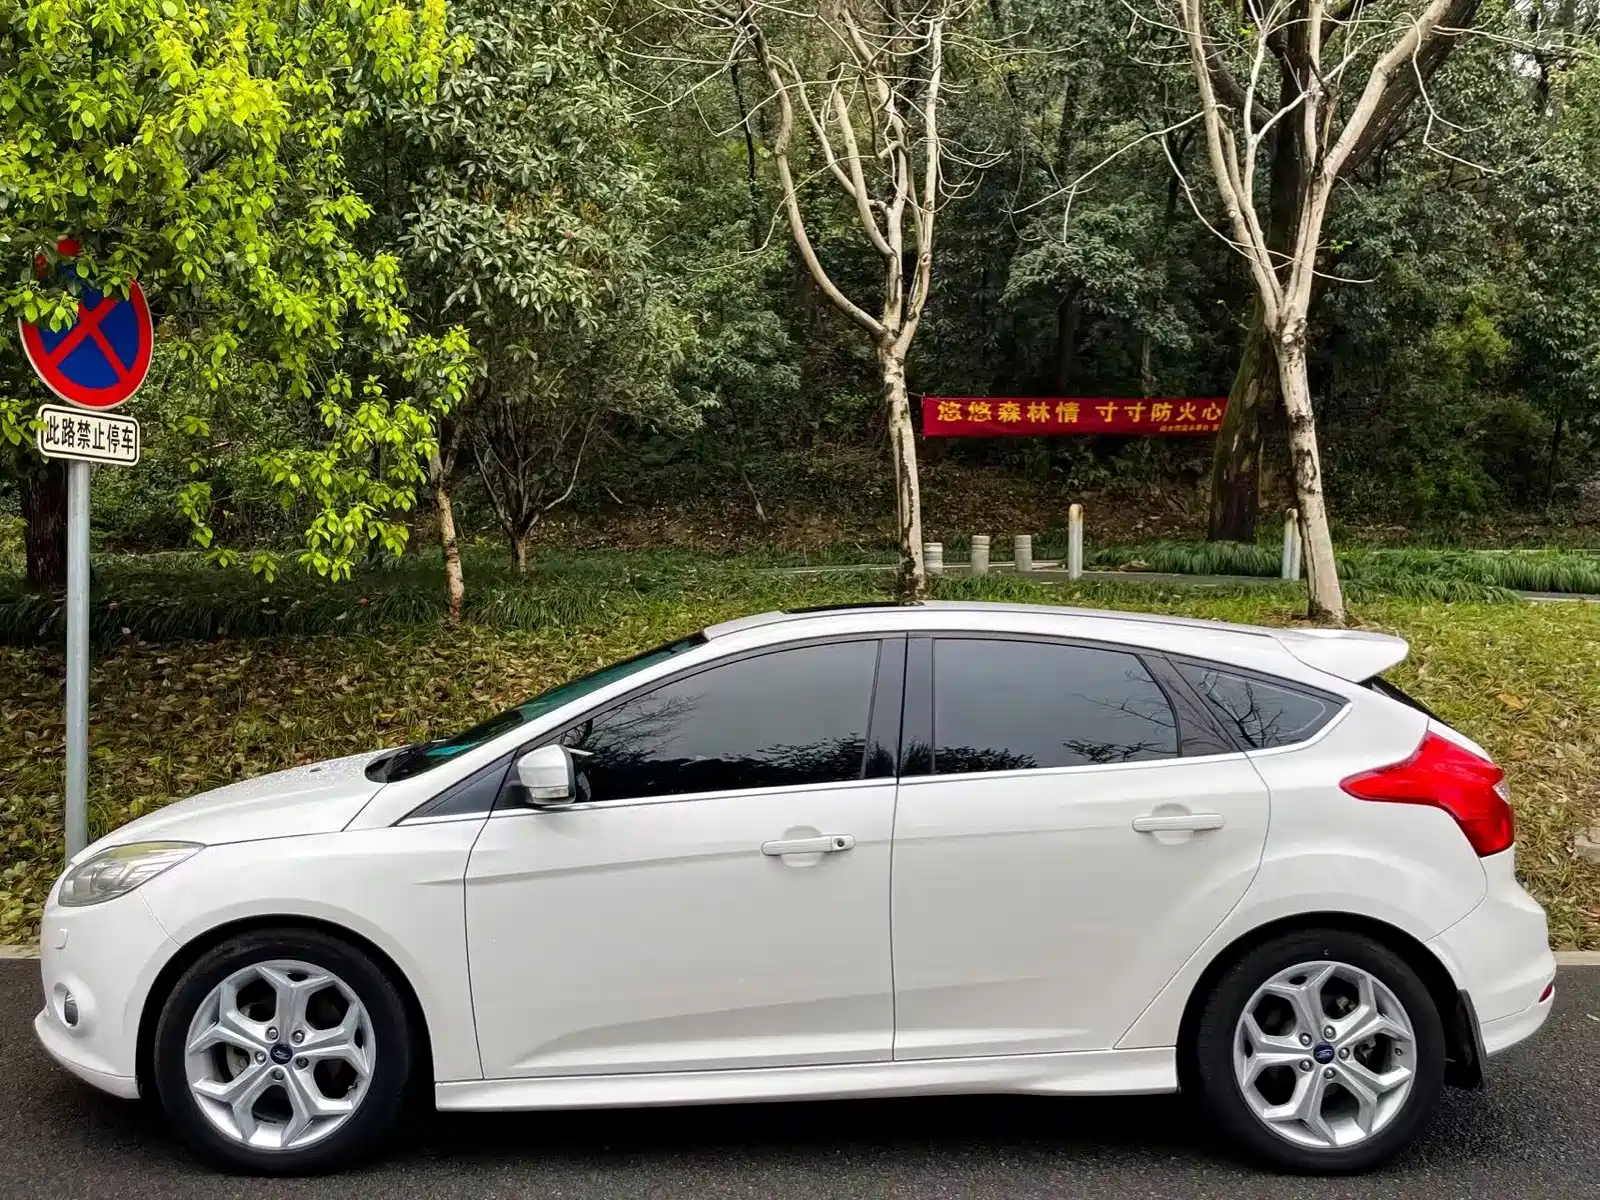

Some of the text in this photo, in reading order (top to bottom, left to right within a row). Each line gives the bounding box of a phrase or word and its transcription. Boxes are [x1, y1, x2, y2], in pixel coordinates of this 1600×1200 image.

[937, 401, 1222, 423] 悠悠森林情 寸寸防火心
[45, 415, 134, 455] 此路禁止停车
